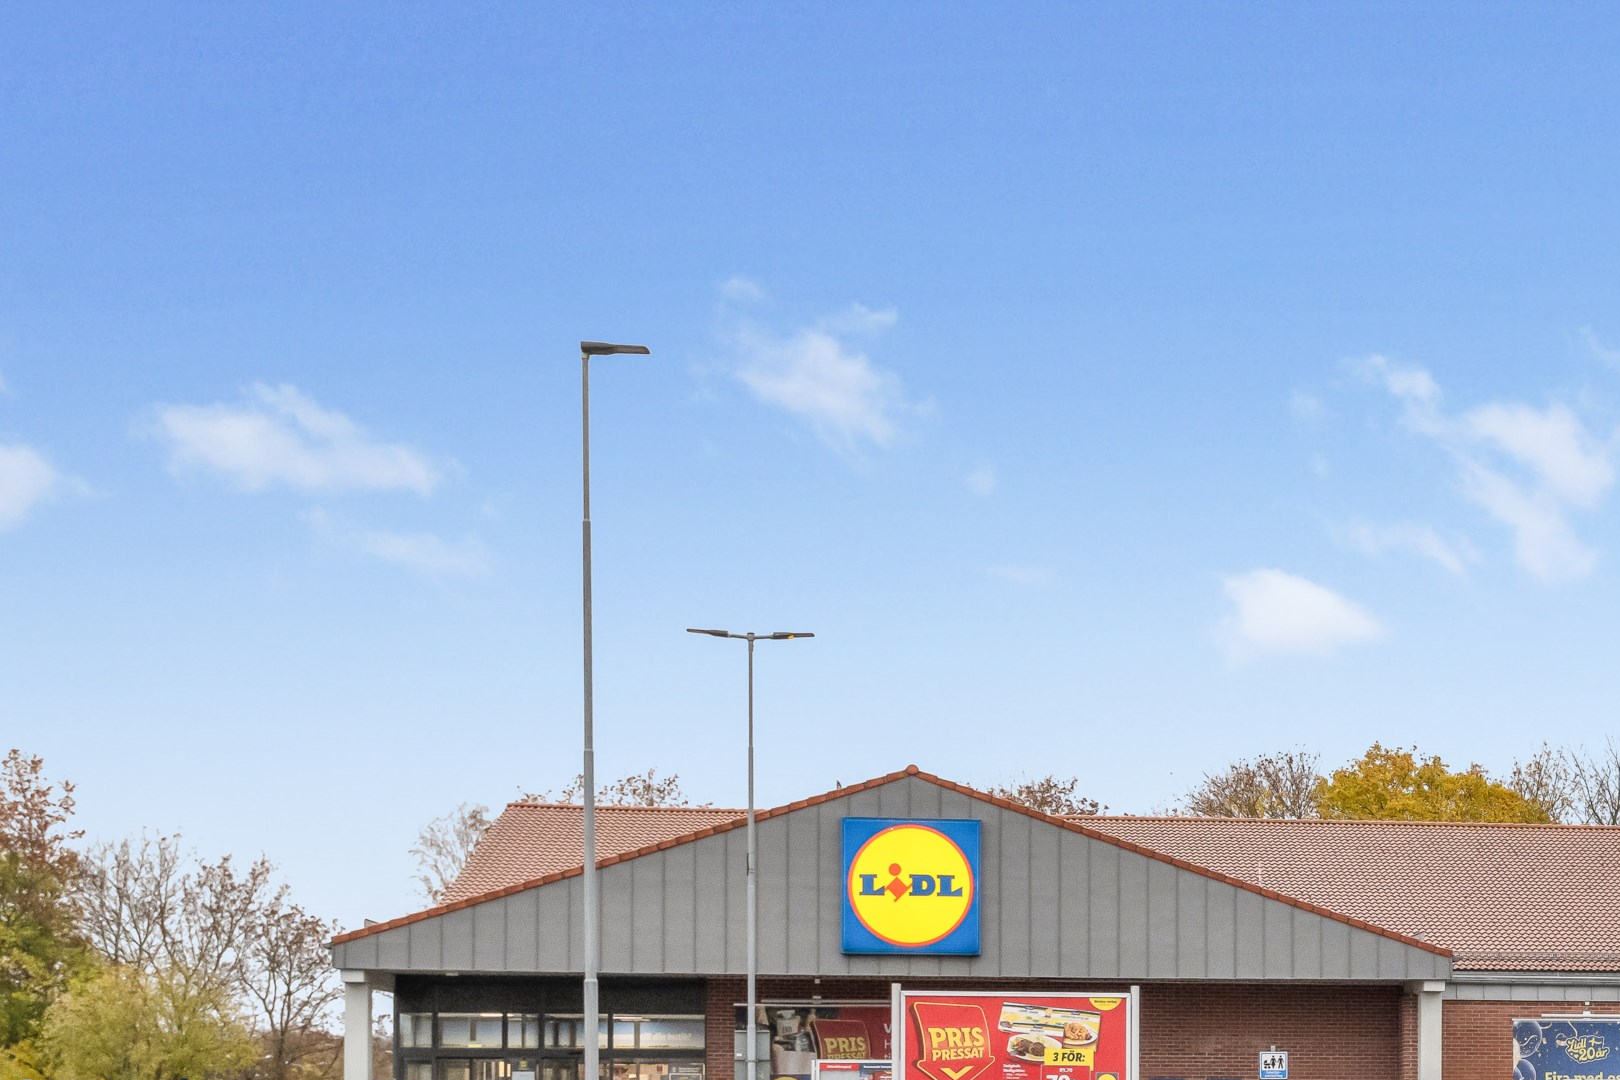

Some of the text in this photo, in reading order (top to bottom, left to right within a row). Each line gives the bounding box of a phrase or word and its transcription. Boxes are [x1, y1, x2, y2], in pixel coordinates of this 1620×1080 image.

[824, 1036, 866, 1052] PRIS
[928, 1027, 985, 1048] PRIS
[932, 1047, 985, 1061] PRESSAT
[1052, 1050, 1086, 1062] 3 FÖR:
[1579, 1046, 1595, 1061] 20
